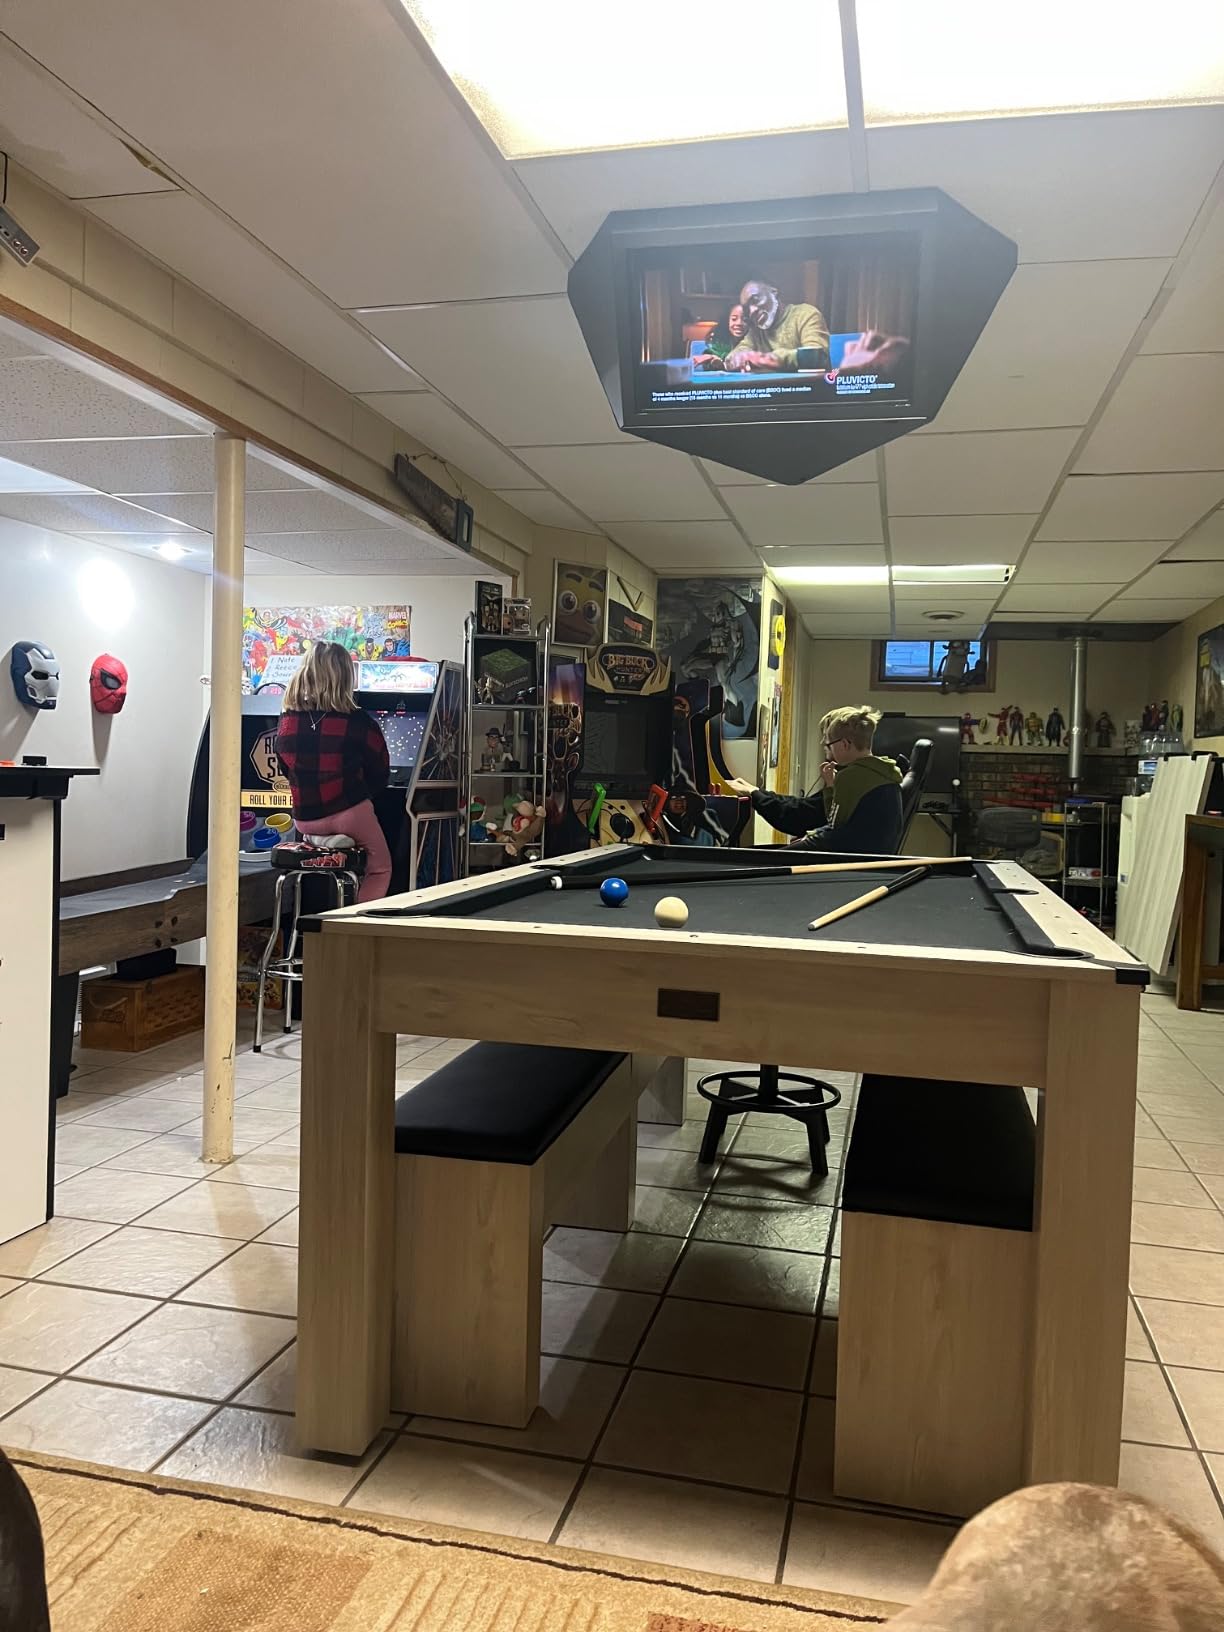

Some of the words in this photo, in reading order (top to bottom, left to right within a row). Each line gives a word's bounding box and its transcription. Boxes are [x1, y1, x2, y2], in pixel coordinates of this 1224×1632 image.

[837, 375, 876, 384] PLUVICTO
[249, 794, 266, 805] ROLL
[269, 794, 287, 805] YOUR
